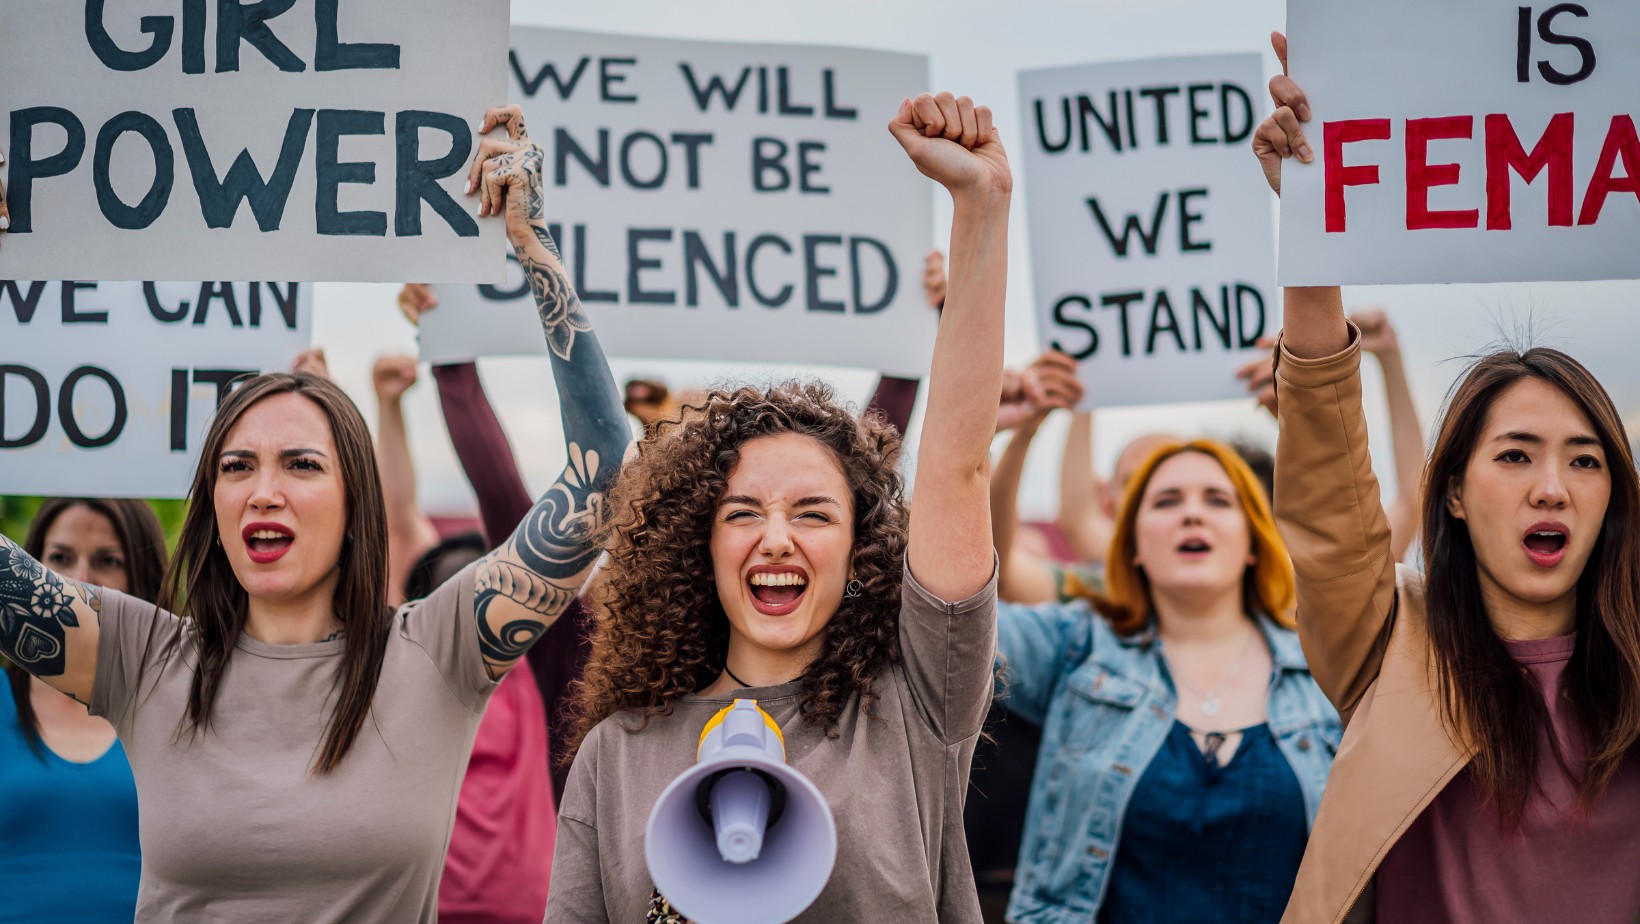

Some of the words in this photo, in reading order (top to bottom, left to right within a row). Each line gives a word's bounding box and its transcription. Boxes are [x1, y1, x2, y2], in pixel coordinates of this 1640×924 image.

[84, 0, 400, 74] GIRL
[1516, 3, 1597, 85] IS
[509, 48, 638, 103] WE
[678, 62, 860, 121] WILL
[1032, 82, 1255, 155] UNITED
[8, 106, 480, 237] POWER
[554, 127, 714, 191] NOT
[751, 136, 831, 195] BE
[1323, 111, 1640, 233] FEMA
[1085, 187, 1212, 258] WE
[142, 280, 299, 329] CAN
[1051, 283, 1266, 361] STAND
[0, 364, 128, 449] DO
